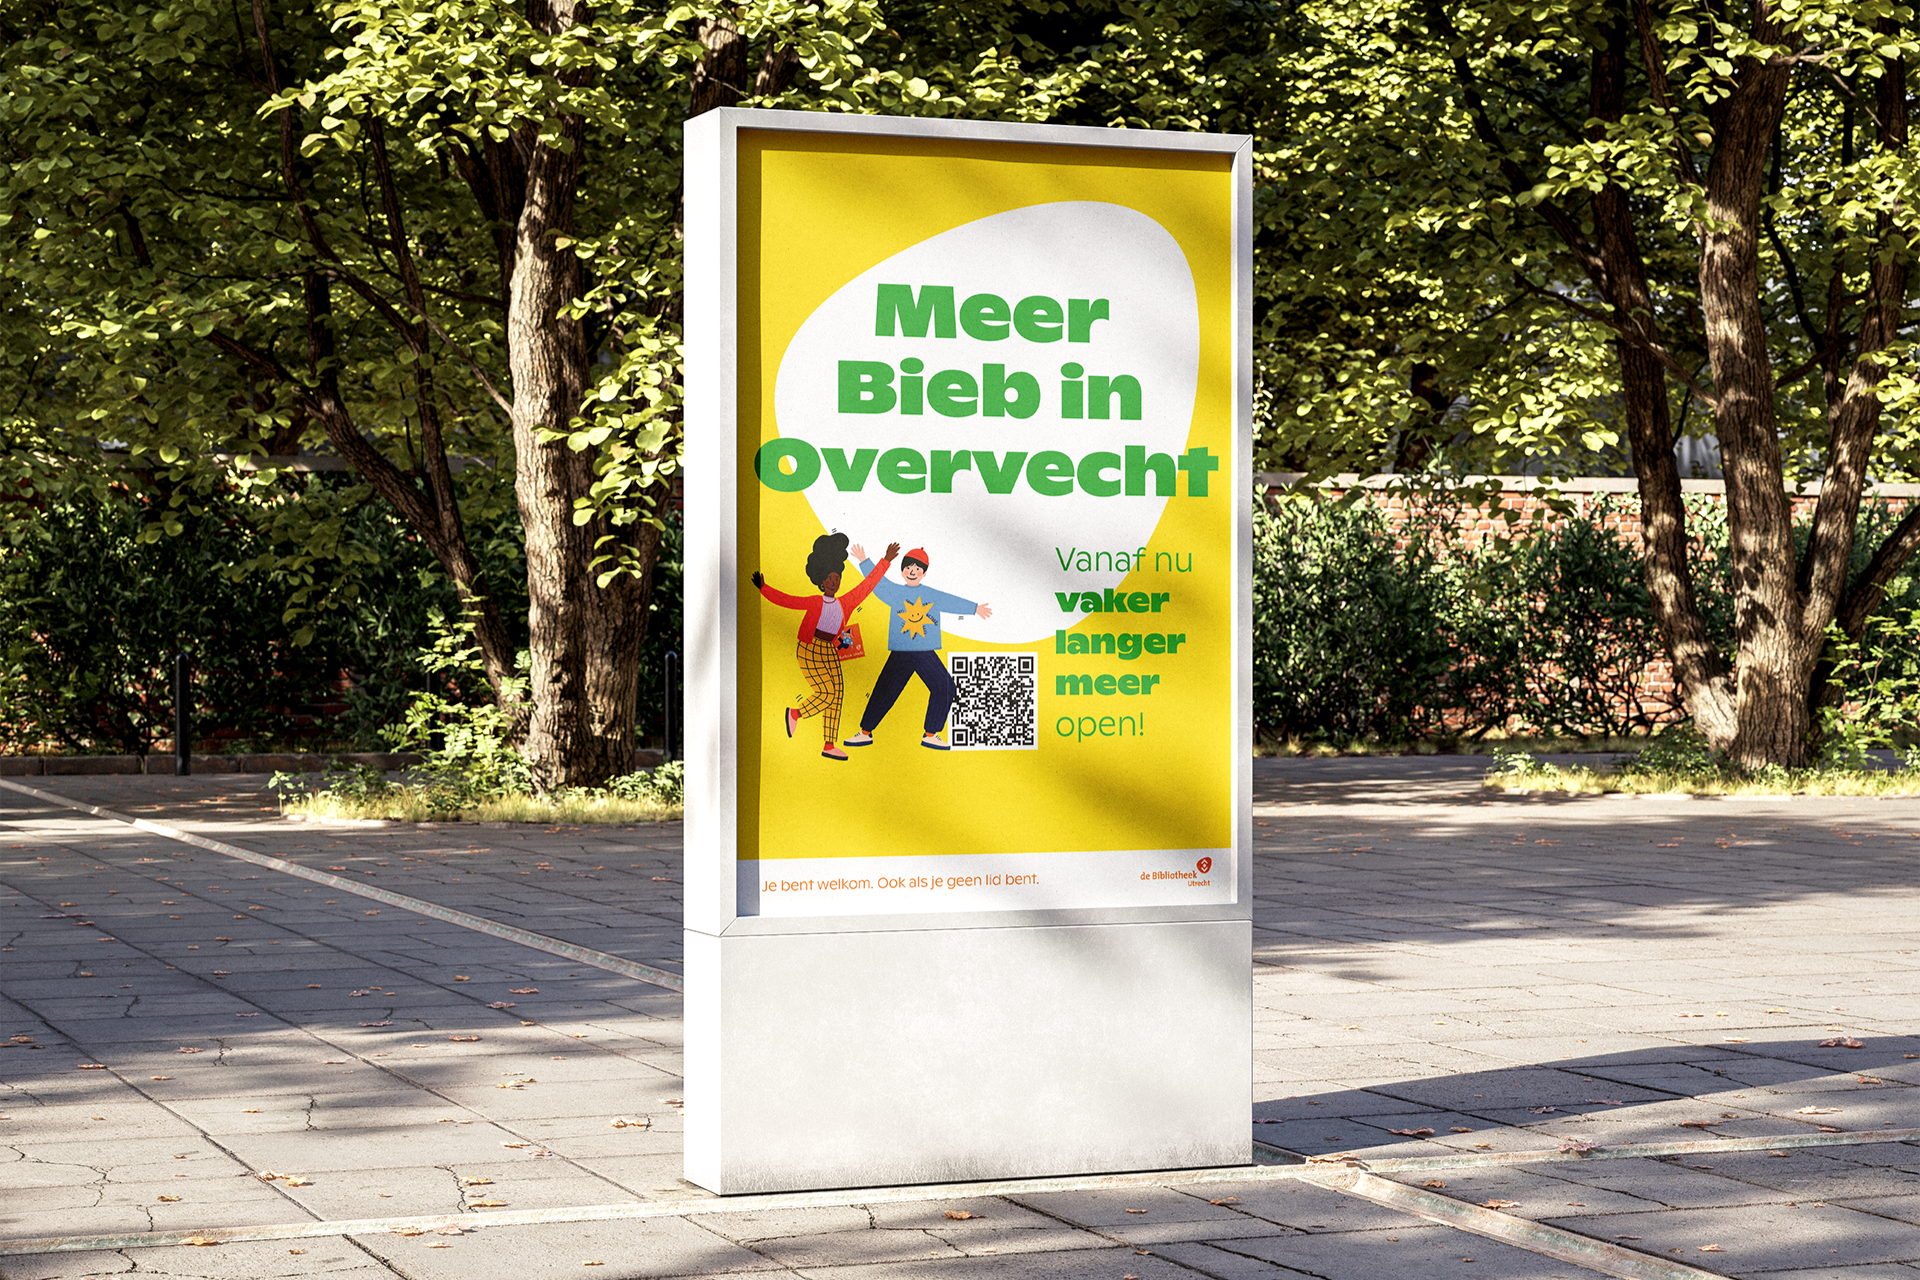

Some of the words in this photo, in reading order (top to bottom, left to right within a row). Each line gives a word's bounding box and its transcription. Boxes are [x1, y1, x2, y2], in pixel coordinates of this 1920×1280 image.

[875, 283, 1110, 343] Meer
[838, 357, 1041, 419] Bieb
[1060, 362, 1142, 421] in
[754, 437, 1219, 498] Overvecht
[1056, 547, 1147, 572] Vanaf
[1155, 552, 1192, 573] nu
[1055, 588, 1170, 613] vaker
[1056, 629, 1186, 660] langer
[1056, 674, 1160, 696] meer
[1056, 712, 1144, 743] open!
[762, 880, 777, 892] Je
[781, 879, 814, 891] bent
[817, 878, 874, 890] welkom.
[878, 876, 906, 889] Ook
[909, 876, 928, 888] als
[930, 875, 943, 890] je
[947, 875, 982, 889] geen
[985, 873, 1001, 886] lid
[1005, 873, 1039, 886] bent.
[1140, 872, 1150, 880] de
[1152, 870, 1197, 880] Bibliotheek
